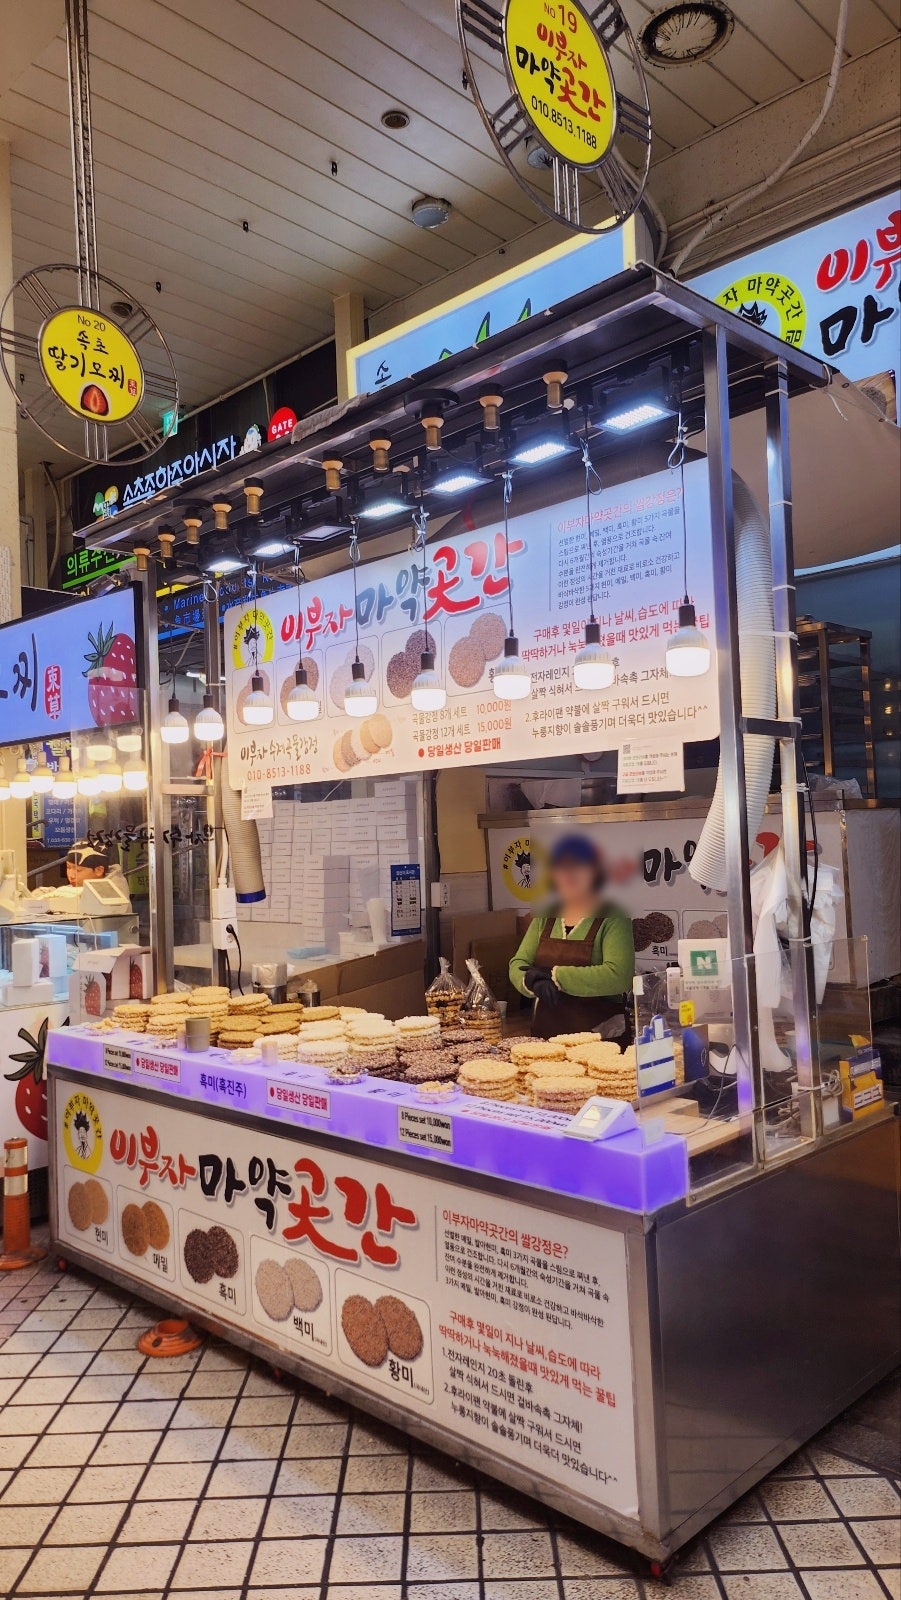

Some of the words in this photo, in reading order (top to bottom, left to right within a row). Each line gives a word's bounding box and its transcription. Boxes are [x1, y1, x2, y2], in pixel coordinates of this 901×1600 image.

[558, 5, 578, 33] 19
[537, 22, 587, 69] 이부자
[531, 95, 597, 149] 010.8513.1188
[77, 314, 91, 327] No
[94, 320, 106, 331] 20
[77, 330, 109, 355] 속초
[48, 346, 125, 389] 딸기모찌
[271, 418, 293, 435] GATE
[173, 592, 204, 611] Marine
[281, 596, 353, 650] 이부자
[533, 624, 560, 642] 구매후
[521, 642, 566, 662] 딱딱하거나
[628, 623, 660, 642] 맛있게
[453, 706, 468, 719] 세트
[477, 700, 512, 715] 10,000원
[565, 703, 590, 717] 약불에
[592, 700, 610, 714] 살짝
[612, 696, 638, 711] 구워서
[641, 691, 669, 706] 드시면
[412, 727, 439, 742] 곡물강정
[457, 723, 471, 736] 세트
[478, 717, 512, 733] 15,000원
[618, 712, 645, 728] 더욱더
[427, 742, 462, 758] 당일생산
[464, 737, 501, 754] 당일판매
[247, 763, 311, 781] 010-8513-1188
[652, 945, 668, 957] 흑미
[696, 956, 713, 970] N
[200, 1073, 247, 1099] 흑미(흑진주)
[276, 1087, 301, 1105] 당일생산
[302, 1092, 328, 1111] 당일판매
[405, 1111, 419, 1123] Pieces
[405, 1128, 420, 1139] Pieces
[110, 1126, 197, 1186] 이부자
[199, 1154, 417, 1265] 마약곳간
[443, 1209, 518, 1246] 이부자마약곳간의
[521, 1232, 569, 1259] 쌀강정은?
[497, 1258, 509, 1269] 다시
[219, 1282, 236, 1305] 흑미
[293, 1315, 314, 1341] 백미
[450, 1310, 475, 1330] 구매후
[477, 1321, 502, 1342] 몇일이
[506, 1332, 523, 1351] 지나
[580, 1361, 601, 1381] 따라
[388, 1359, 413, 1389] 황미
[439, 1324, 481, 1352] 딱딱하거나
[540, 1365, 569, 1389] 맛있게
[572, 1378, 593, 1398] 먹는
[596, 1387, 616, 1409] 꿀팁
[488, 1365, 507, 1383] 20초
[449, 1366, 464, 1382] 살짝
[491, 1384, 515, 1404] 드시면
[518, 1395, 551, 1420] 겉바속촉
[553, 1411, 582, 1434] 그자체!
[483, 1399, 507, 1421] 약불에
[508, 1411, 525, 1430] 살짝
[527, 1419, 552, 1441] 구워서
[555, 1432, 582, 1455] 드시면
[533, 1440, 560, 1462] 더욱더
